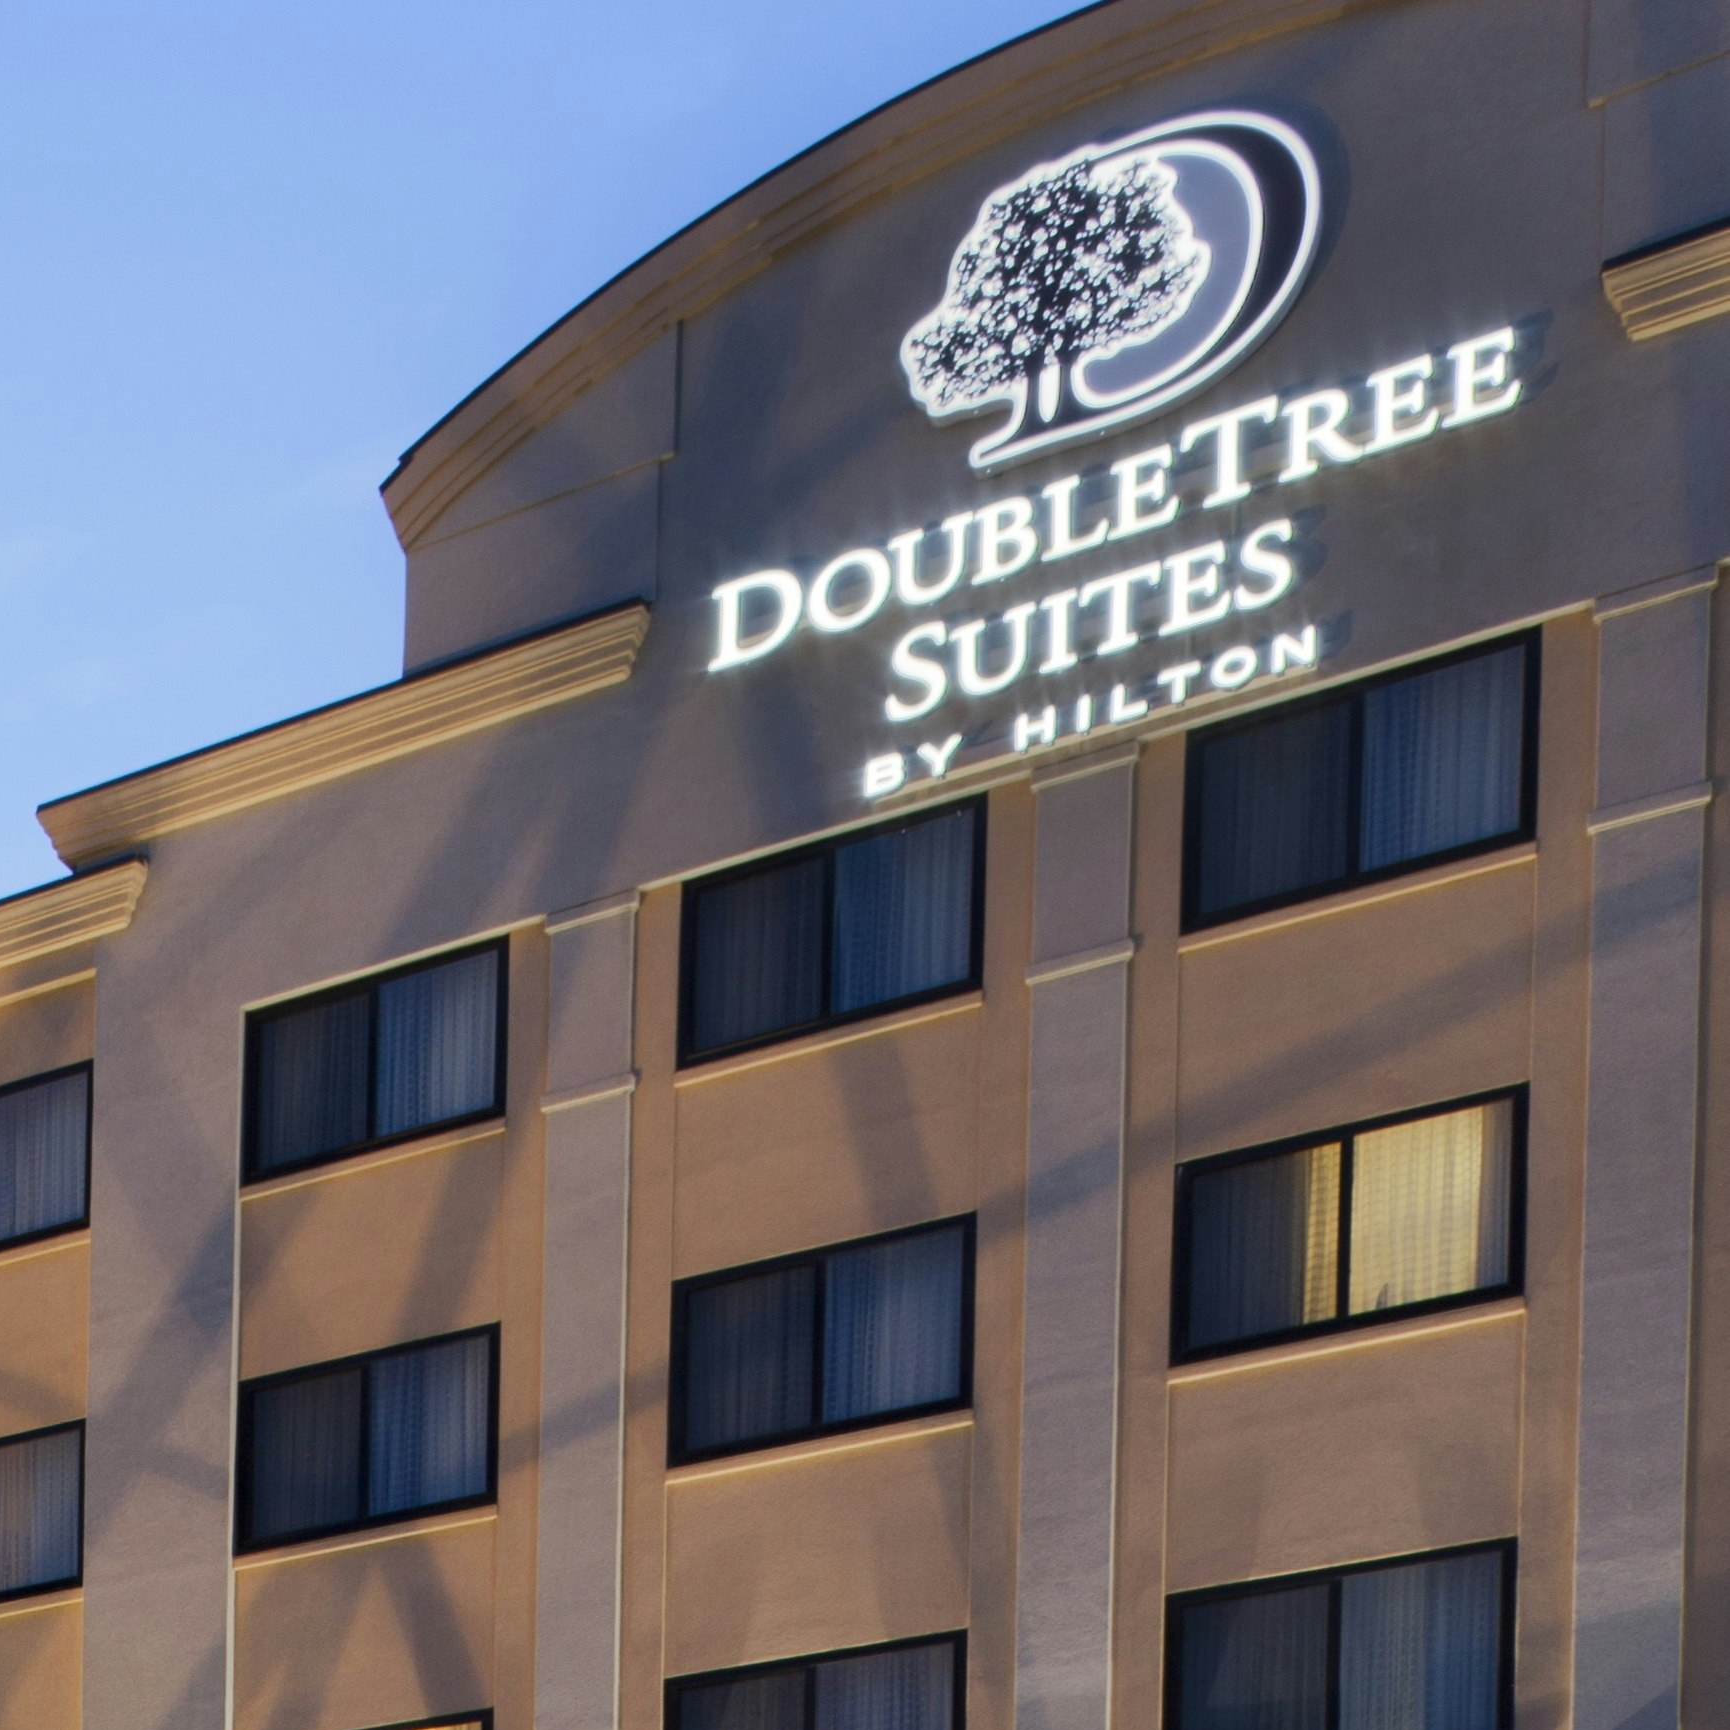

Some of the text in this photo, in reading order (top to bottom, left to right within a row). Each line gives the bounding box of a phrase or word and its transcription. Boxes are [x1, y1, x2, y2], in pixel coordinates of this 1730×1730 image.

[706, 327, 1523, 673] DOUBLETREE
[864, 626, 1318, 798] BY HILTON
[886, 519, 1294, 722] SUITES
